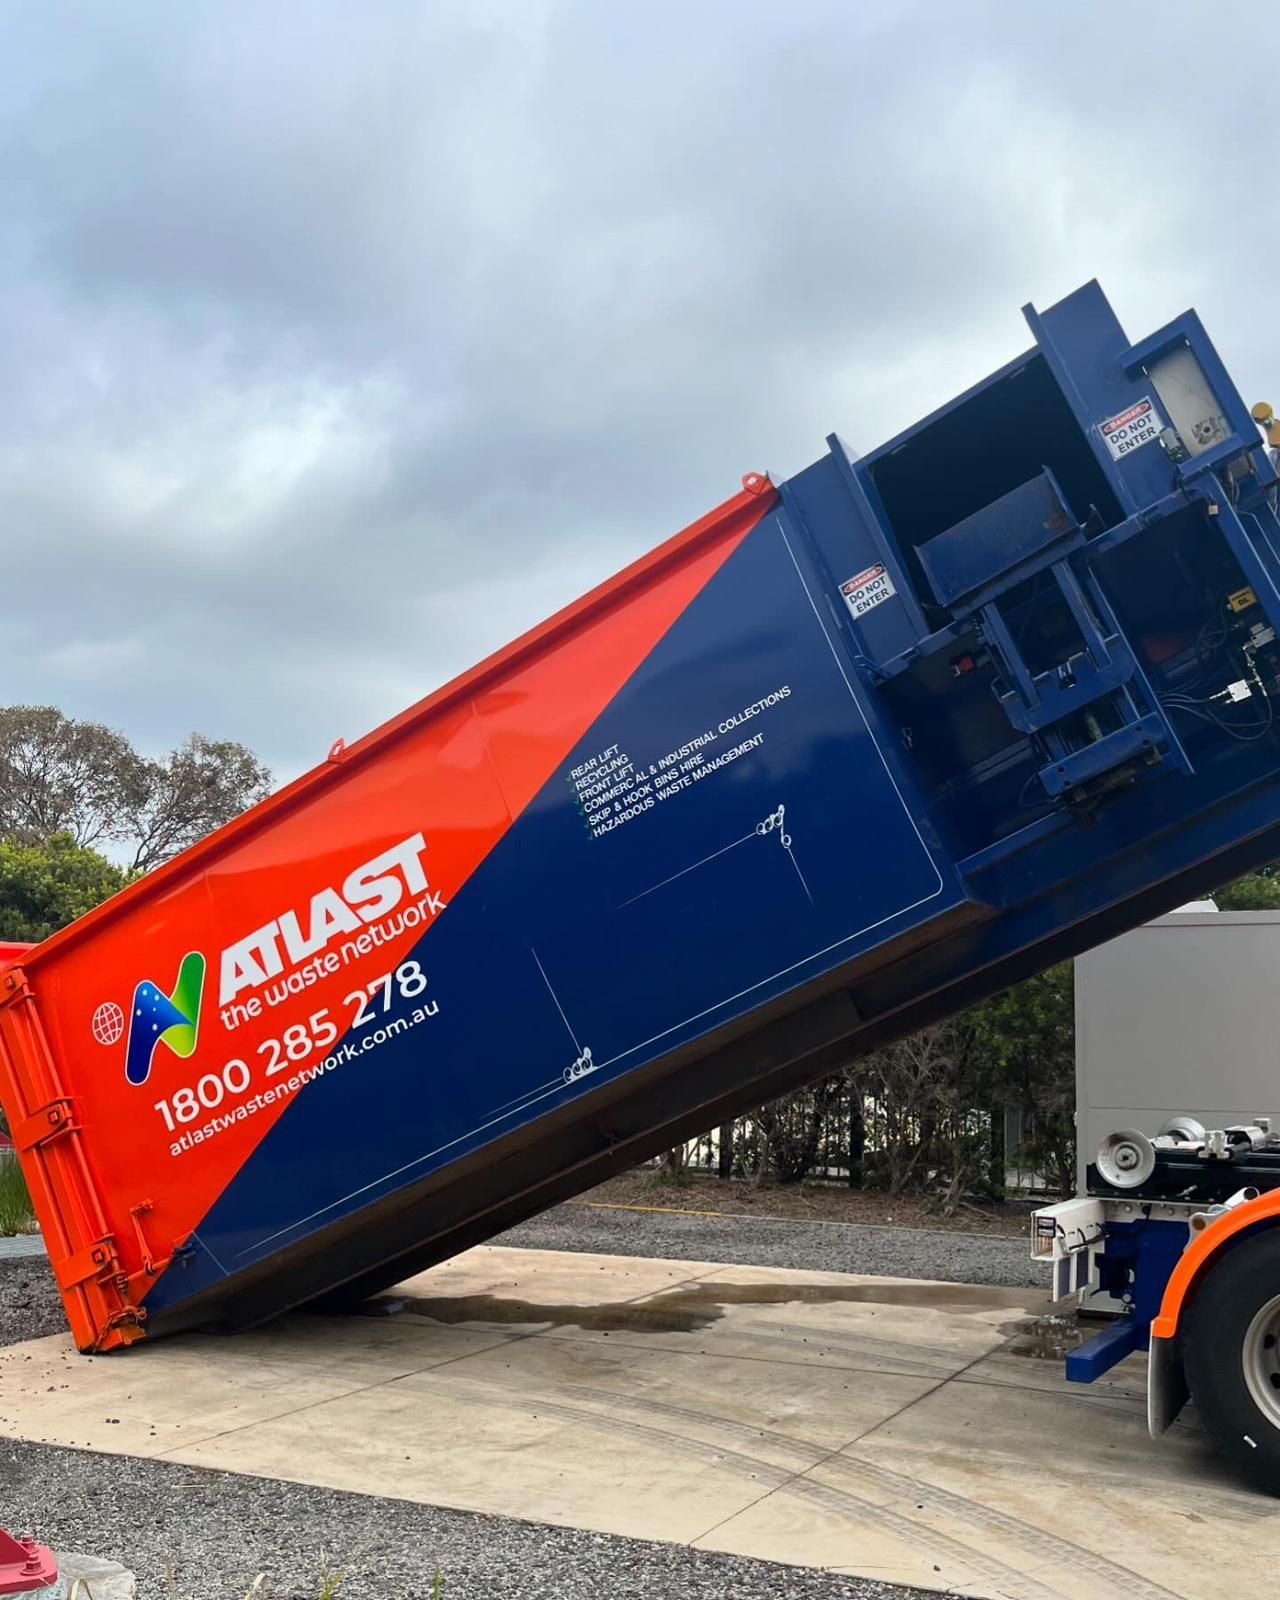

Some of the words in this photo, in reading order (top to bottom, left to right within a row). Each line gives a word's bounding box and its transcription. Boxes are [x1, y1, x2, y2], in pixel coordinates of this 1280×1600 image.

[1110, 429, 1127, 444] DO
[1128, 413, 1152, 433] NOT
[1118, 426, 1156, 454] ENTER
[849, 591, 865, 604] DO
[865, 576, 885, 594] NOT
[856, 588, 889, 613] ENTER
[650, 764, 658, 776] &
[658, 731, 718, 767] INDUSTRIAL
[718, 685, 792, 734] COLLECTIONS
[571, 758, 598, 779] REAR
[598, 744, 620, 763] LIFT
[575, 754, 629, 791] RECYCLING
[579, 778, 612, 802] FRONT
[613, 763, 635, 783] LIFT
[589, 808, 612, 826] SKIP
[614, 802, 623, 813] &
[624, 785, 653, 804] HOOK
[654, 770, 679, 787] BINS
[679, 753, 705, 773] HIRE
[592, 798, 655, 838] HAZARDOUS
[655, 775, 692, 801] WASTE
[692, 732, 765, 781] MANAGEMENT
[218, 831, 428, 1007] ATLAST
[220, 997, 263, 1031] the
[264, 951, 341, 1008] waste
[341, 889, 448, 964] network
[154, 1059, 251, 1132] 1800
[256, 1008, 338, 1077] 285
[342, 960, 429, 1030] 278
[169, 1000, 440, 1157] atlastwastenetwork.com.au
